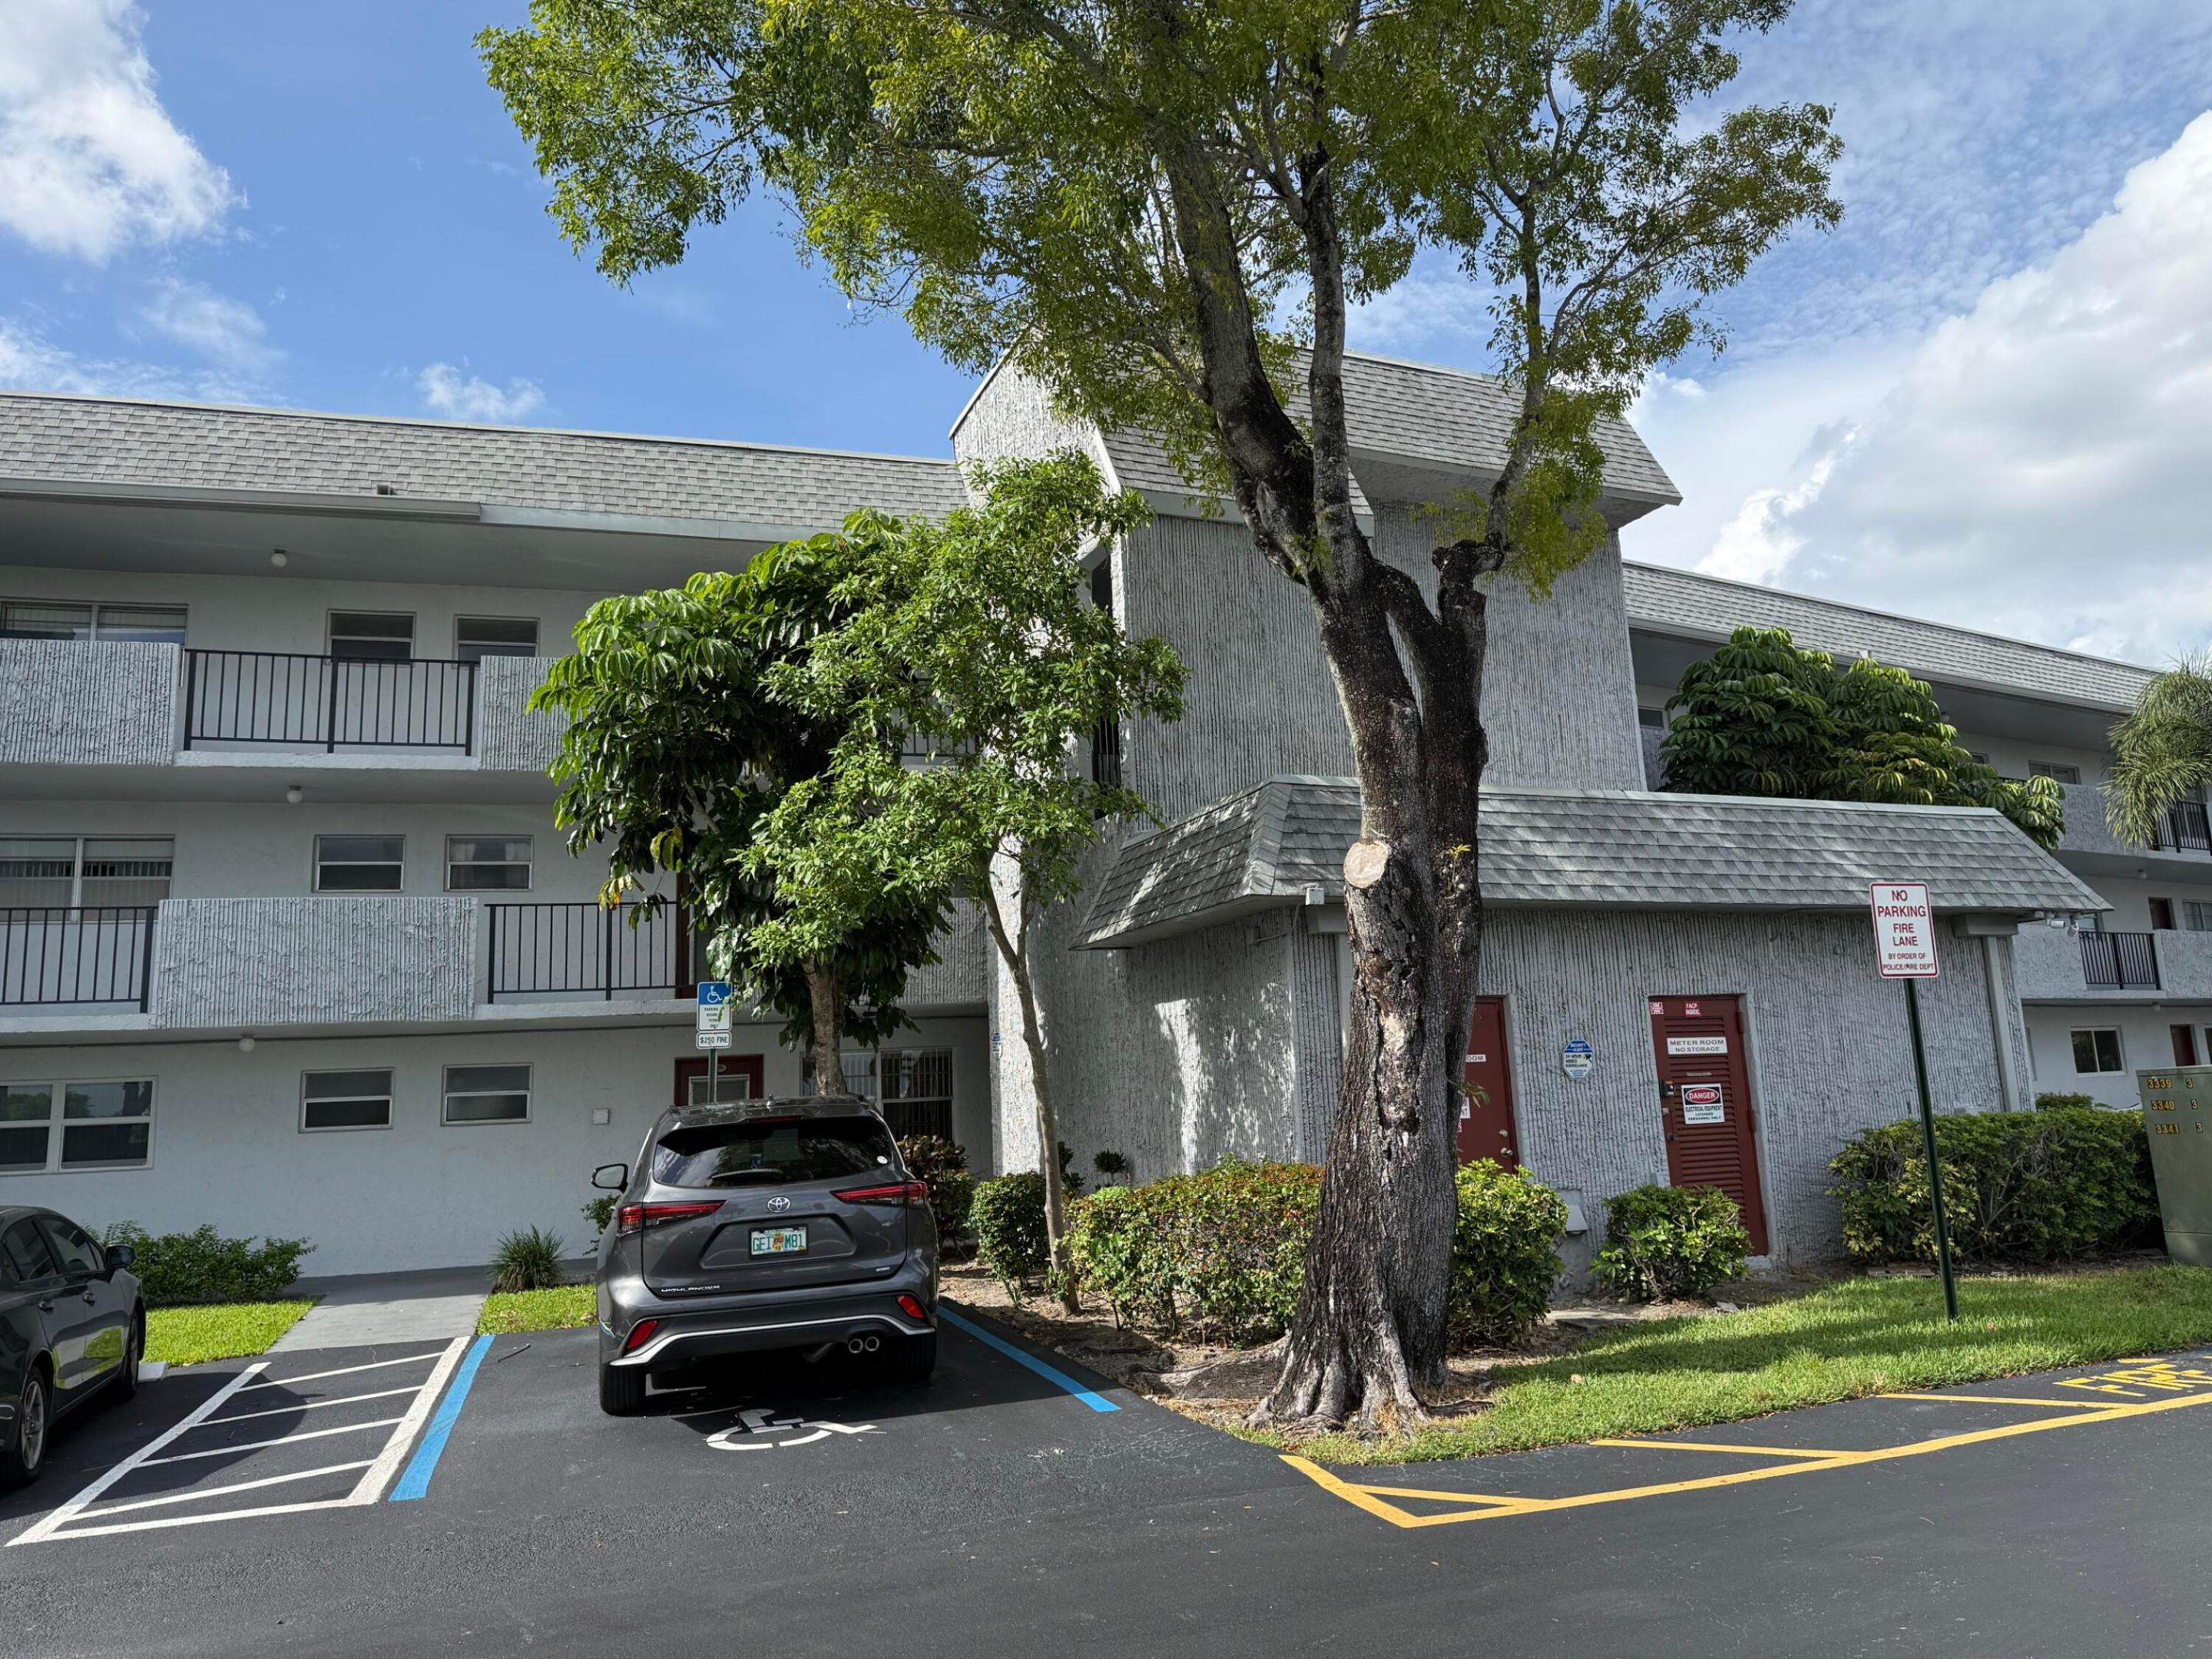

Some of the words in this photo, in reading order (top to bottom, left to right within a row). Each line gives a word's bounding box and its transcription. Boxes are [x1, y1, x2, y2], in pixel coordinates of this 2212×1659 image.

[1891, 890, 1908, 902] NO
[1877, 906, 1926, 917] PARKING
[1892, 923, 1915, 933] FIRE
[1892, 936, 1919, 946] LANE
[2148, 1078, 2172, 1088] 3339
[2187, 1078, 2194, 1088] 3
[1689, 1091, 1716, 1100] DANGER
[2151, 1101, 2175, 1110] 3340
[2191, 1099, 2198, 1109] 3
[2156, 1124, 2180, 1134] 3341
[2197, 1122, 2203, 1132] 3
